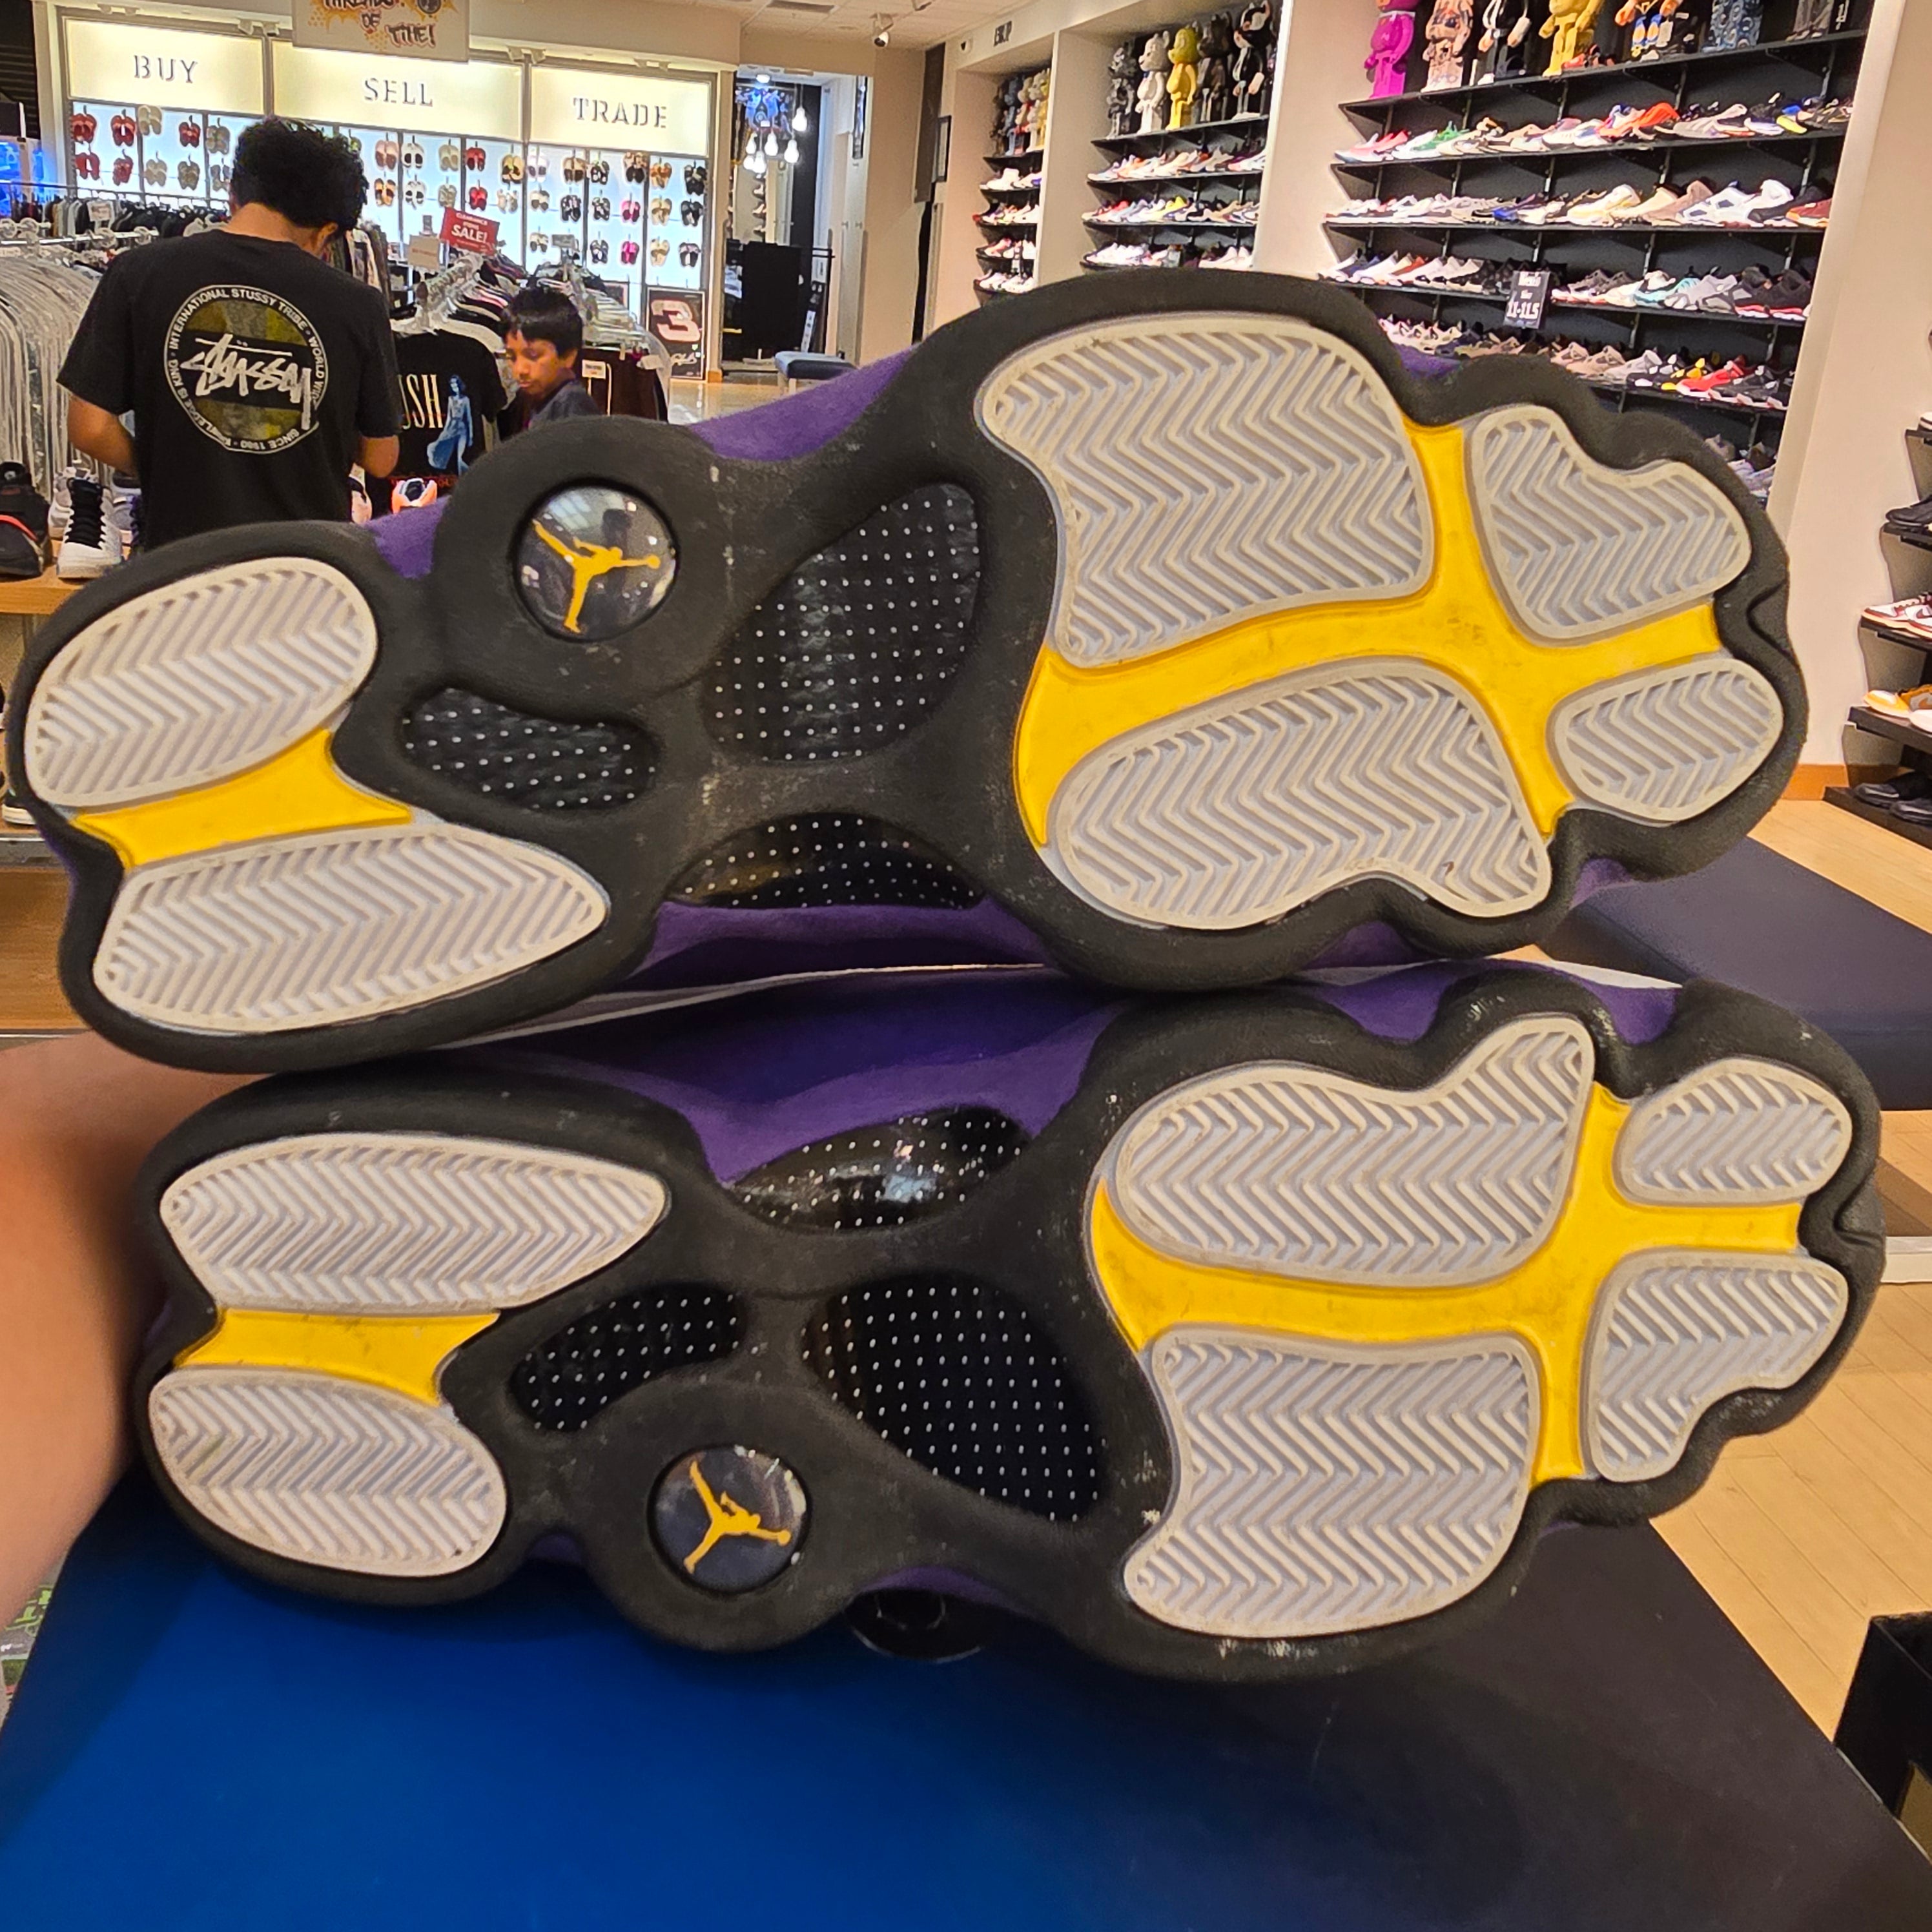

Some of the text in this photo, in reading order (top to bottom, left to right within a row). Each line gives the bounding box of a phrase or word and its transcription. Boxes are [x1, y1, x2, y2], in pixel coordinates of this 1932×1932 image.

[134, 54, 198, 83] BUY
[364, 77, 433, 107] SELL
[573, 97, 667, 128] TRADE
[169, 289, 230, 349] INTERNATIONAL
[278, 302, 308, 331] TRIBE
[309, 336, 325, 380] WORLD
